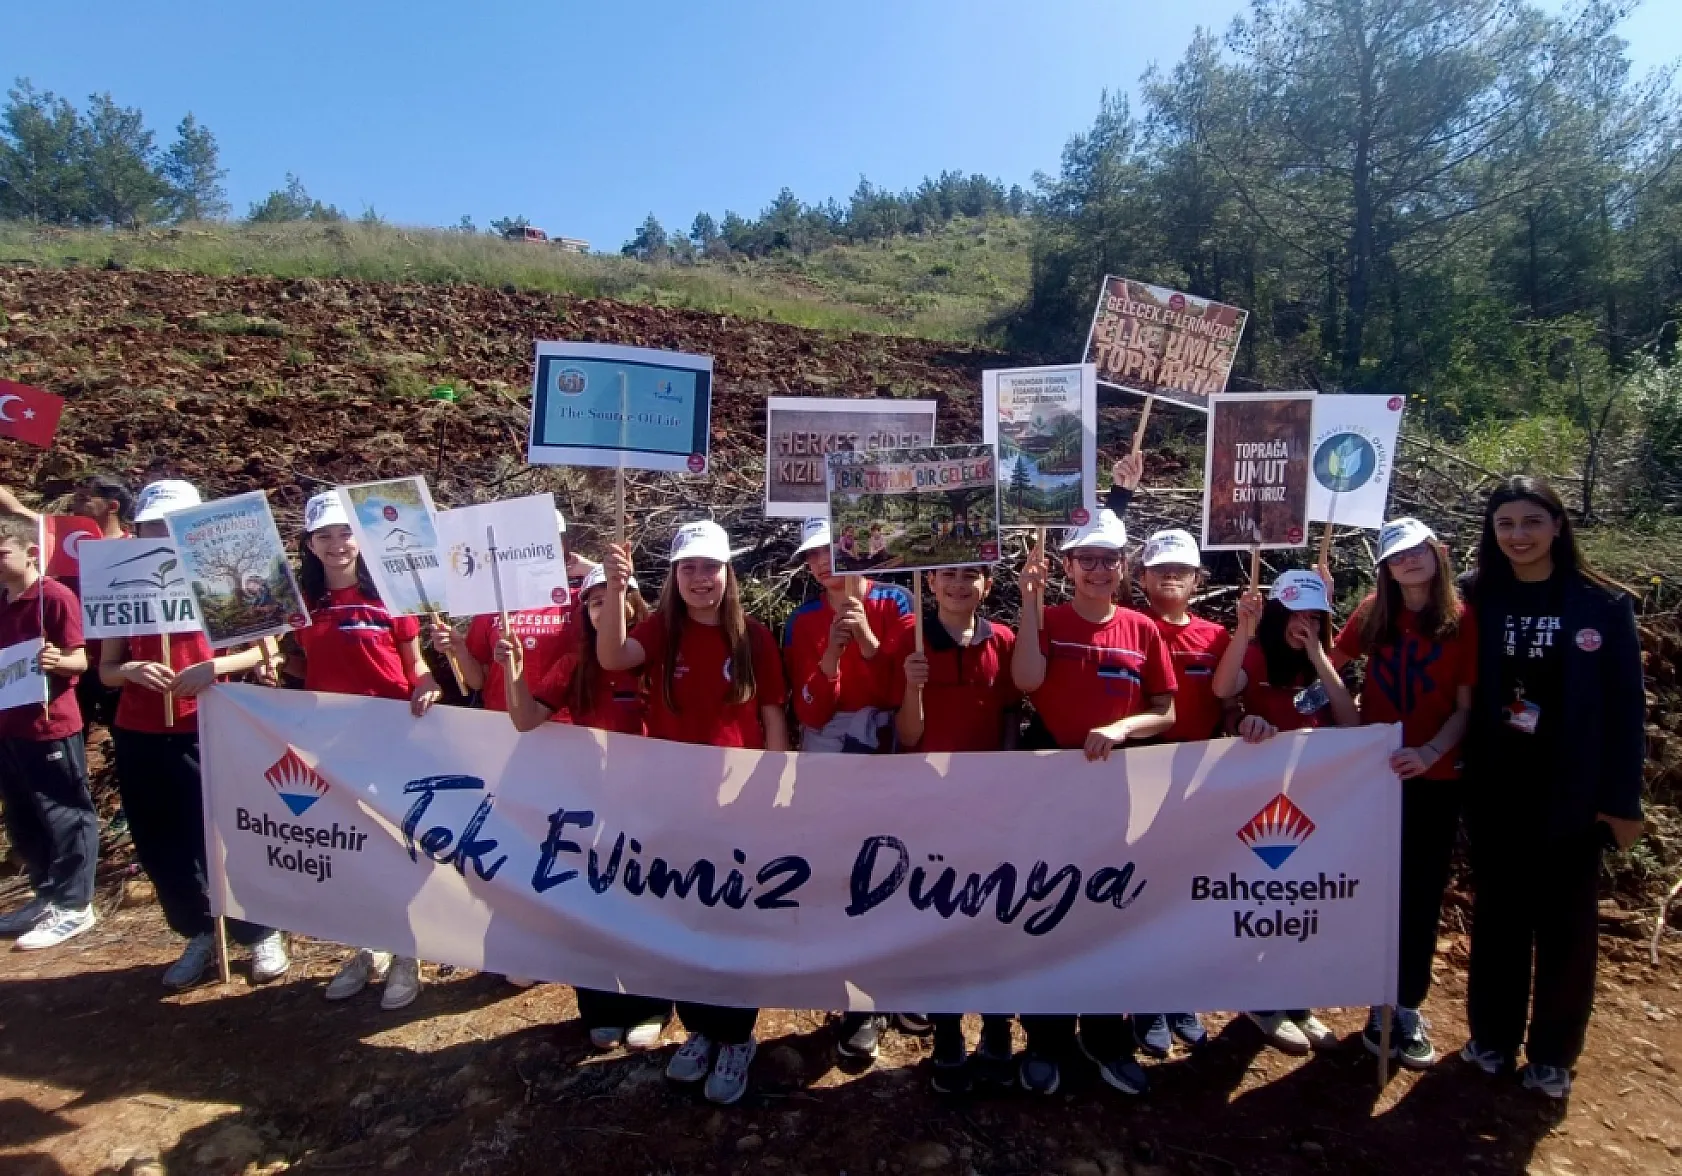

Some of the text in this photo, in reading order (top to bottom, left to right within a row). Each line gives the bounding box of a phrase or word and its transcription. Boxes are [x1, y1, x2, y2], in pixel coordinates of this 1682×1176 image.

[1235, 439, 1288, 459] TOPRAĞA
[1233, 460, 1288, 484] UMUT
[237, 807, 368, 853] Bahçeşehir
[266, 845, 333, 882] Koleji
[401, 774, 507, 882] Tek
[845, 835, 1147, 936] Dünya
[1191, 872, 1360, 906] Bahçeşehir
[1233, 909, 1319, 943] Koleji
